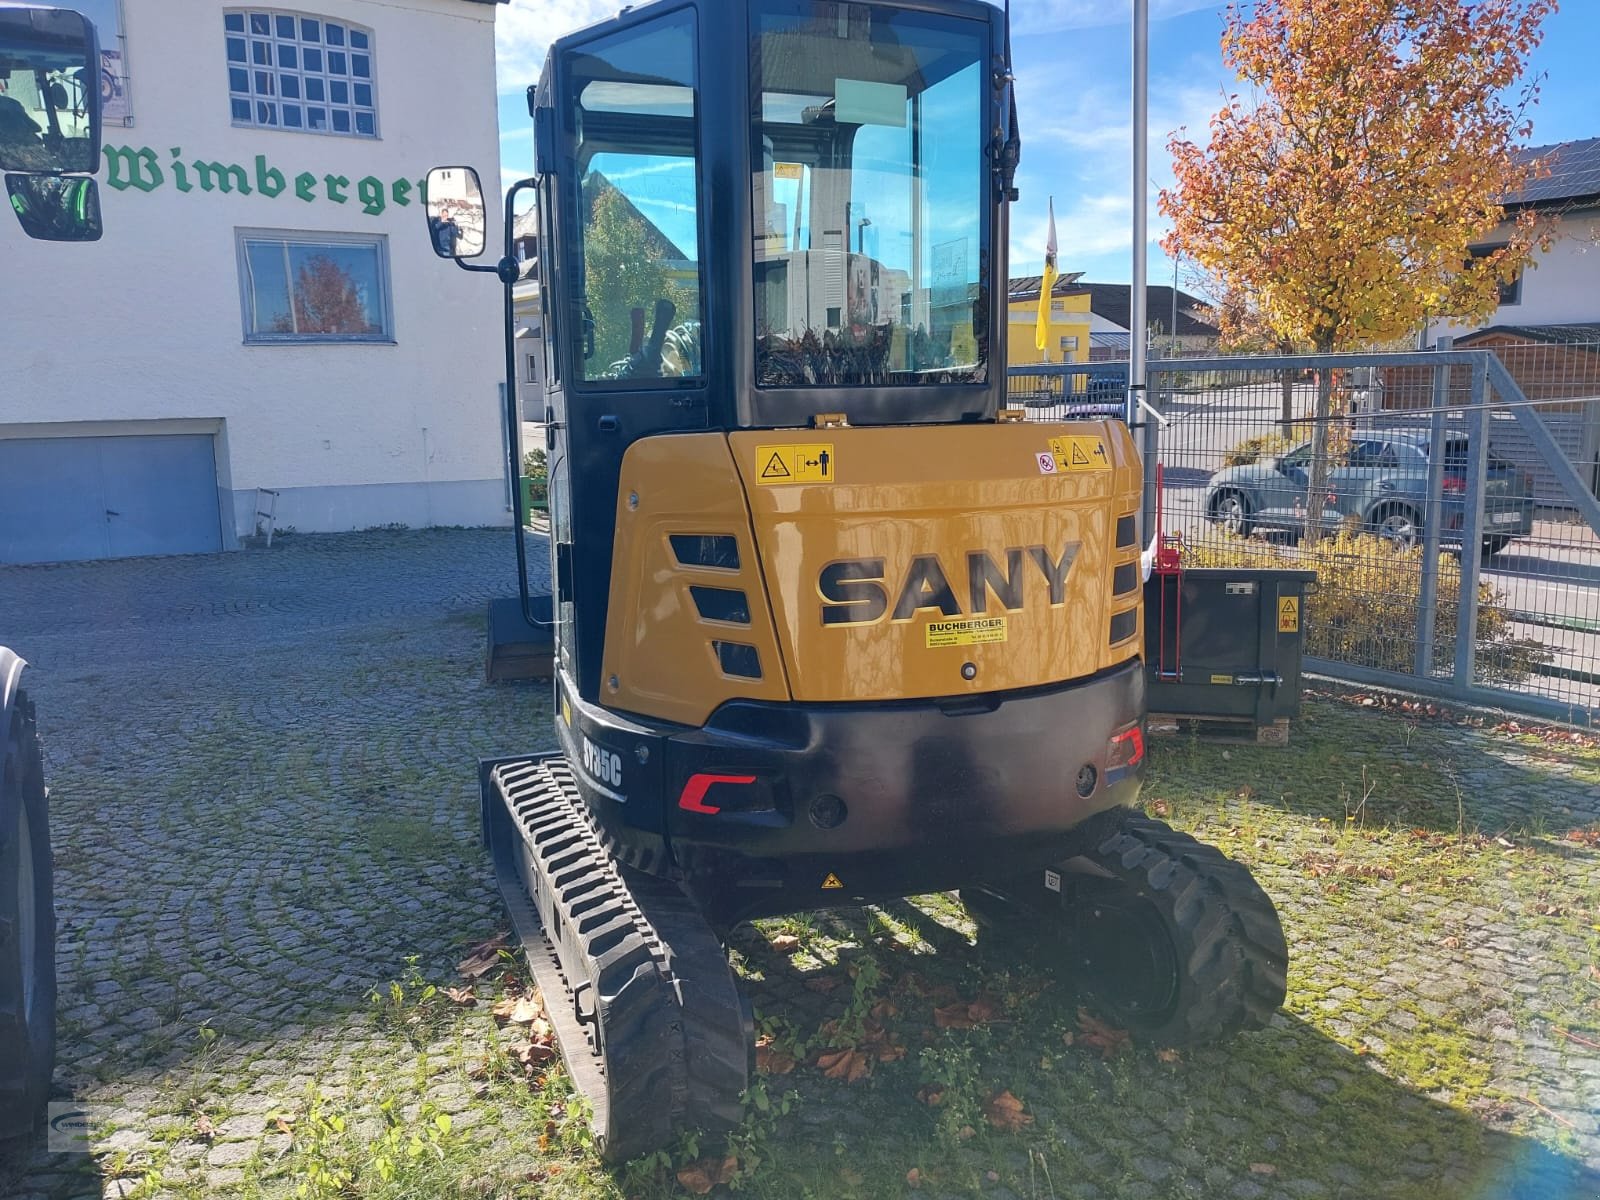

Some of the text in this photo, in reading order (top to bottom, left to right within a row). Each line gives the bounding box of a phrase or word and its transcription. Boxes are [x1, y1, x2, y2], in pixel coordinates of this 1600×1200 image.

[815, 541, 1083, 628] SANY
[929, 619, 1002, 631] BUCHBERGER
[583, 736, 622, 787] SY35C
